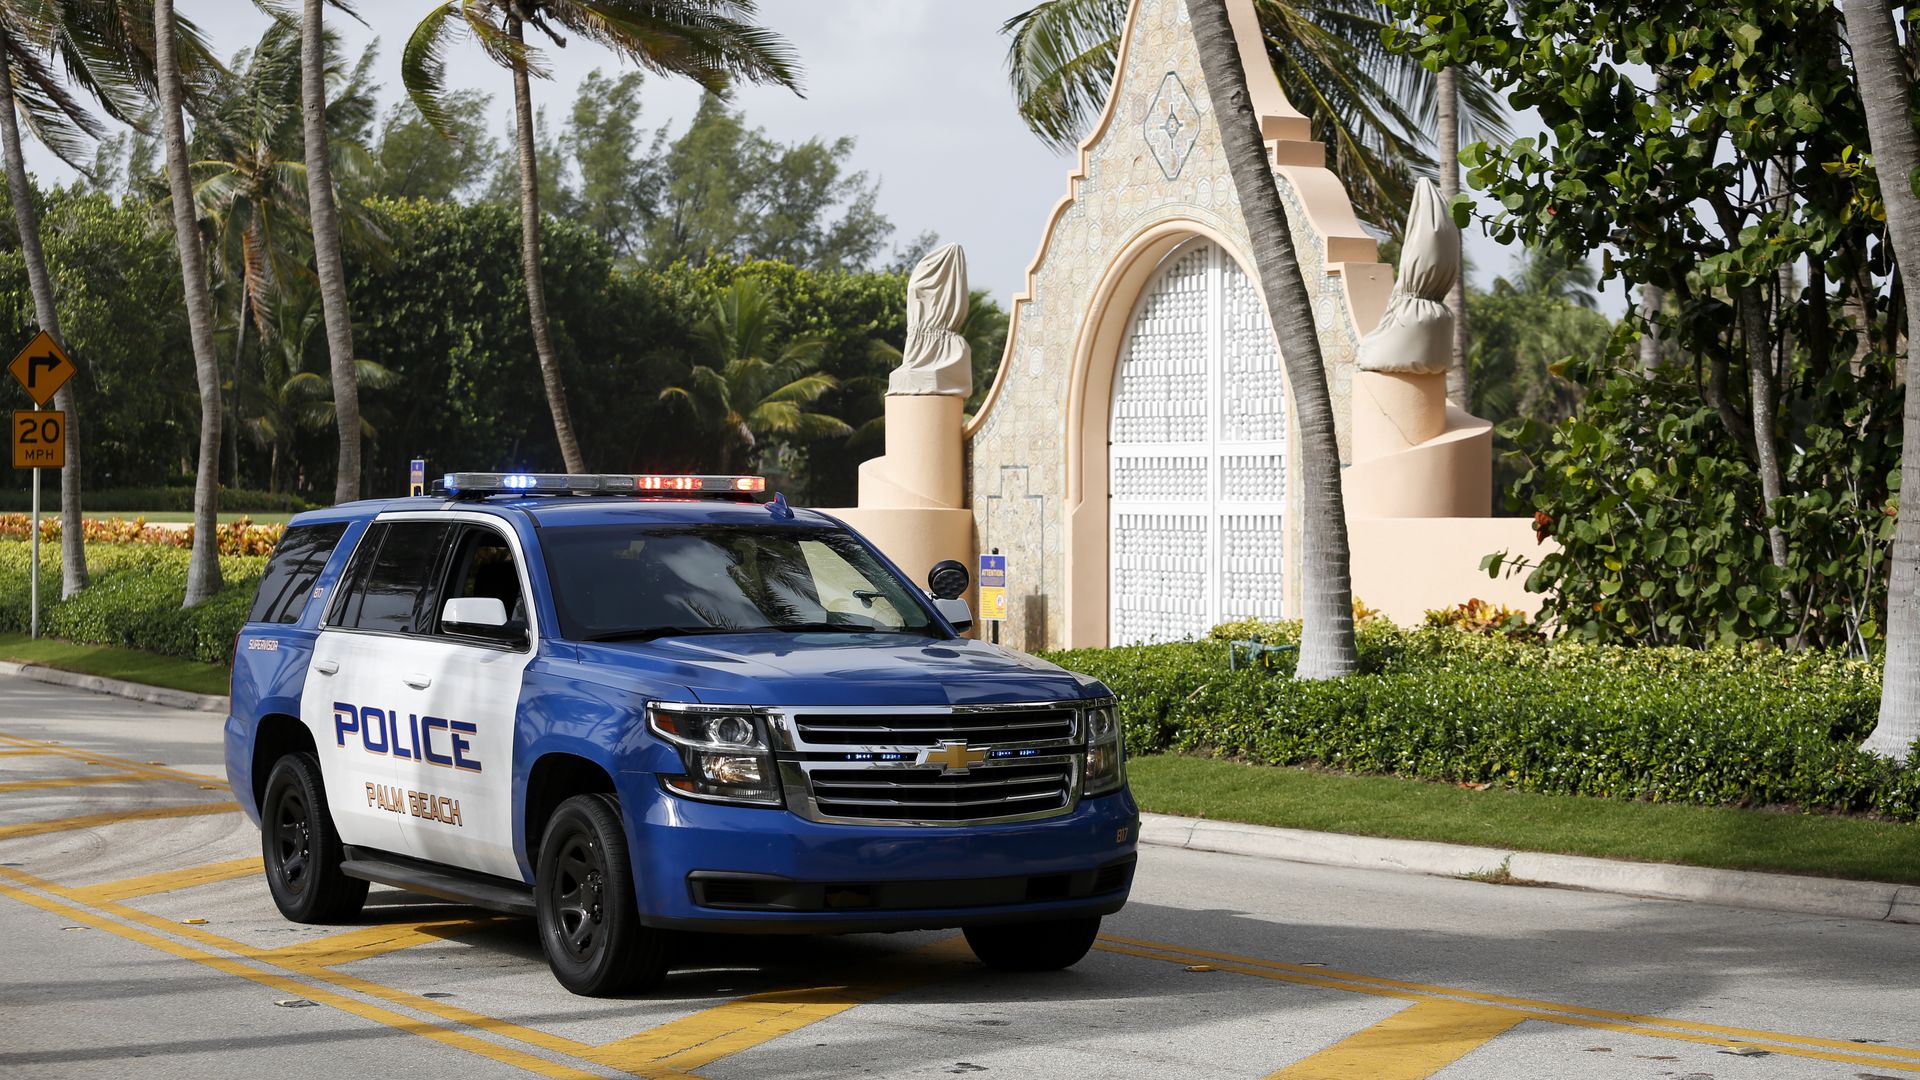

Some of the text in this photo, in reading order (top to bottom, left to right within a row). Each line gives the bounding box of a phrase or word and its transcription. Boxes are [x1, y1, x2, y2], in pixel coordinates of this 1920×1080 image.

[19, 418, 60, 444] 20
[25, 449, 54, 461] MPH
[248, 639, 279, 651] SUPERVISOR
[333, 701, 482, 774] POLICE
[365, 781, 463, 827] PALM BEACH
[1116, 827, 1129, 843] 817
